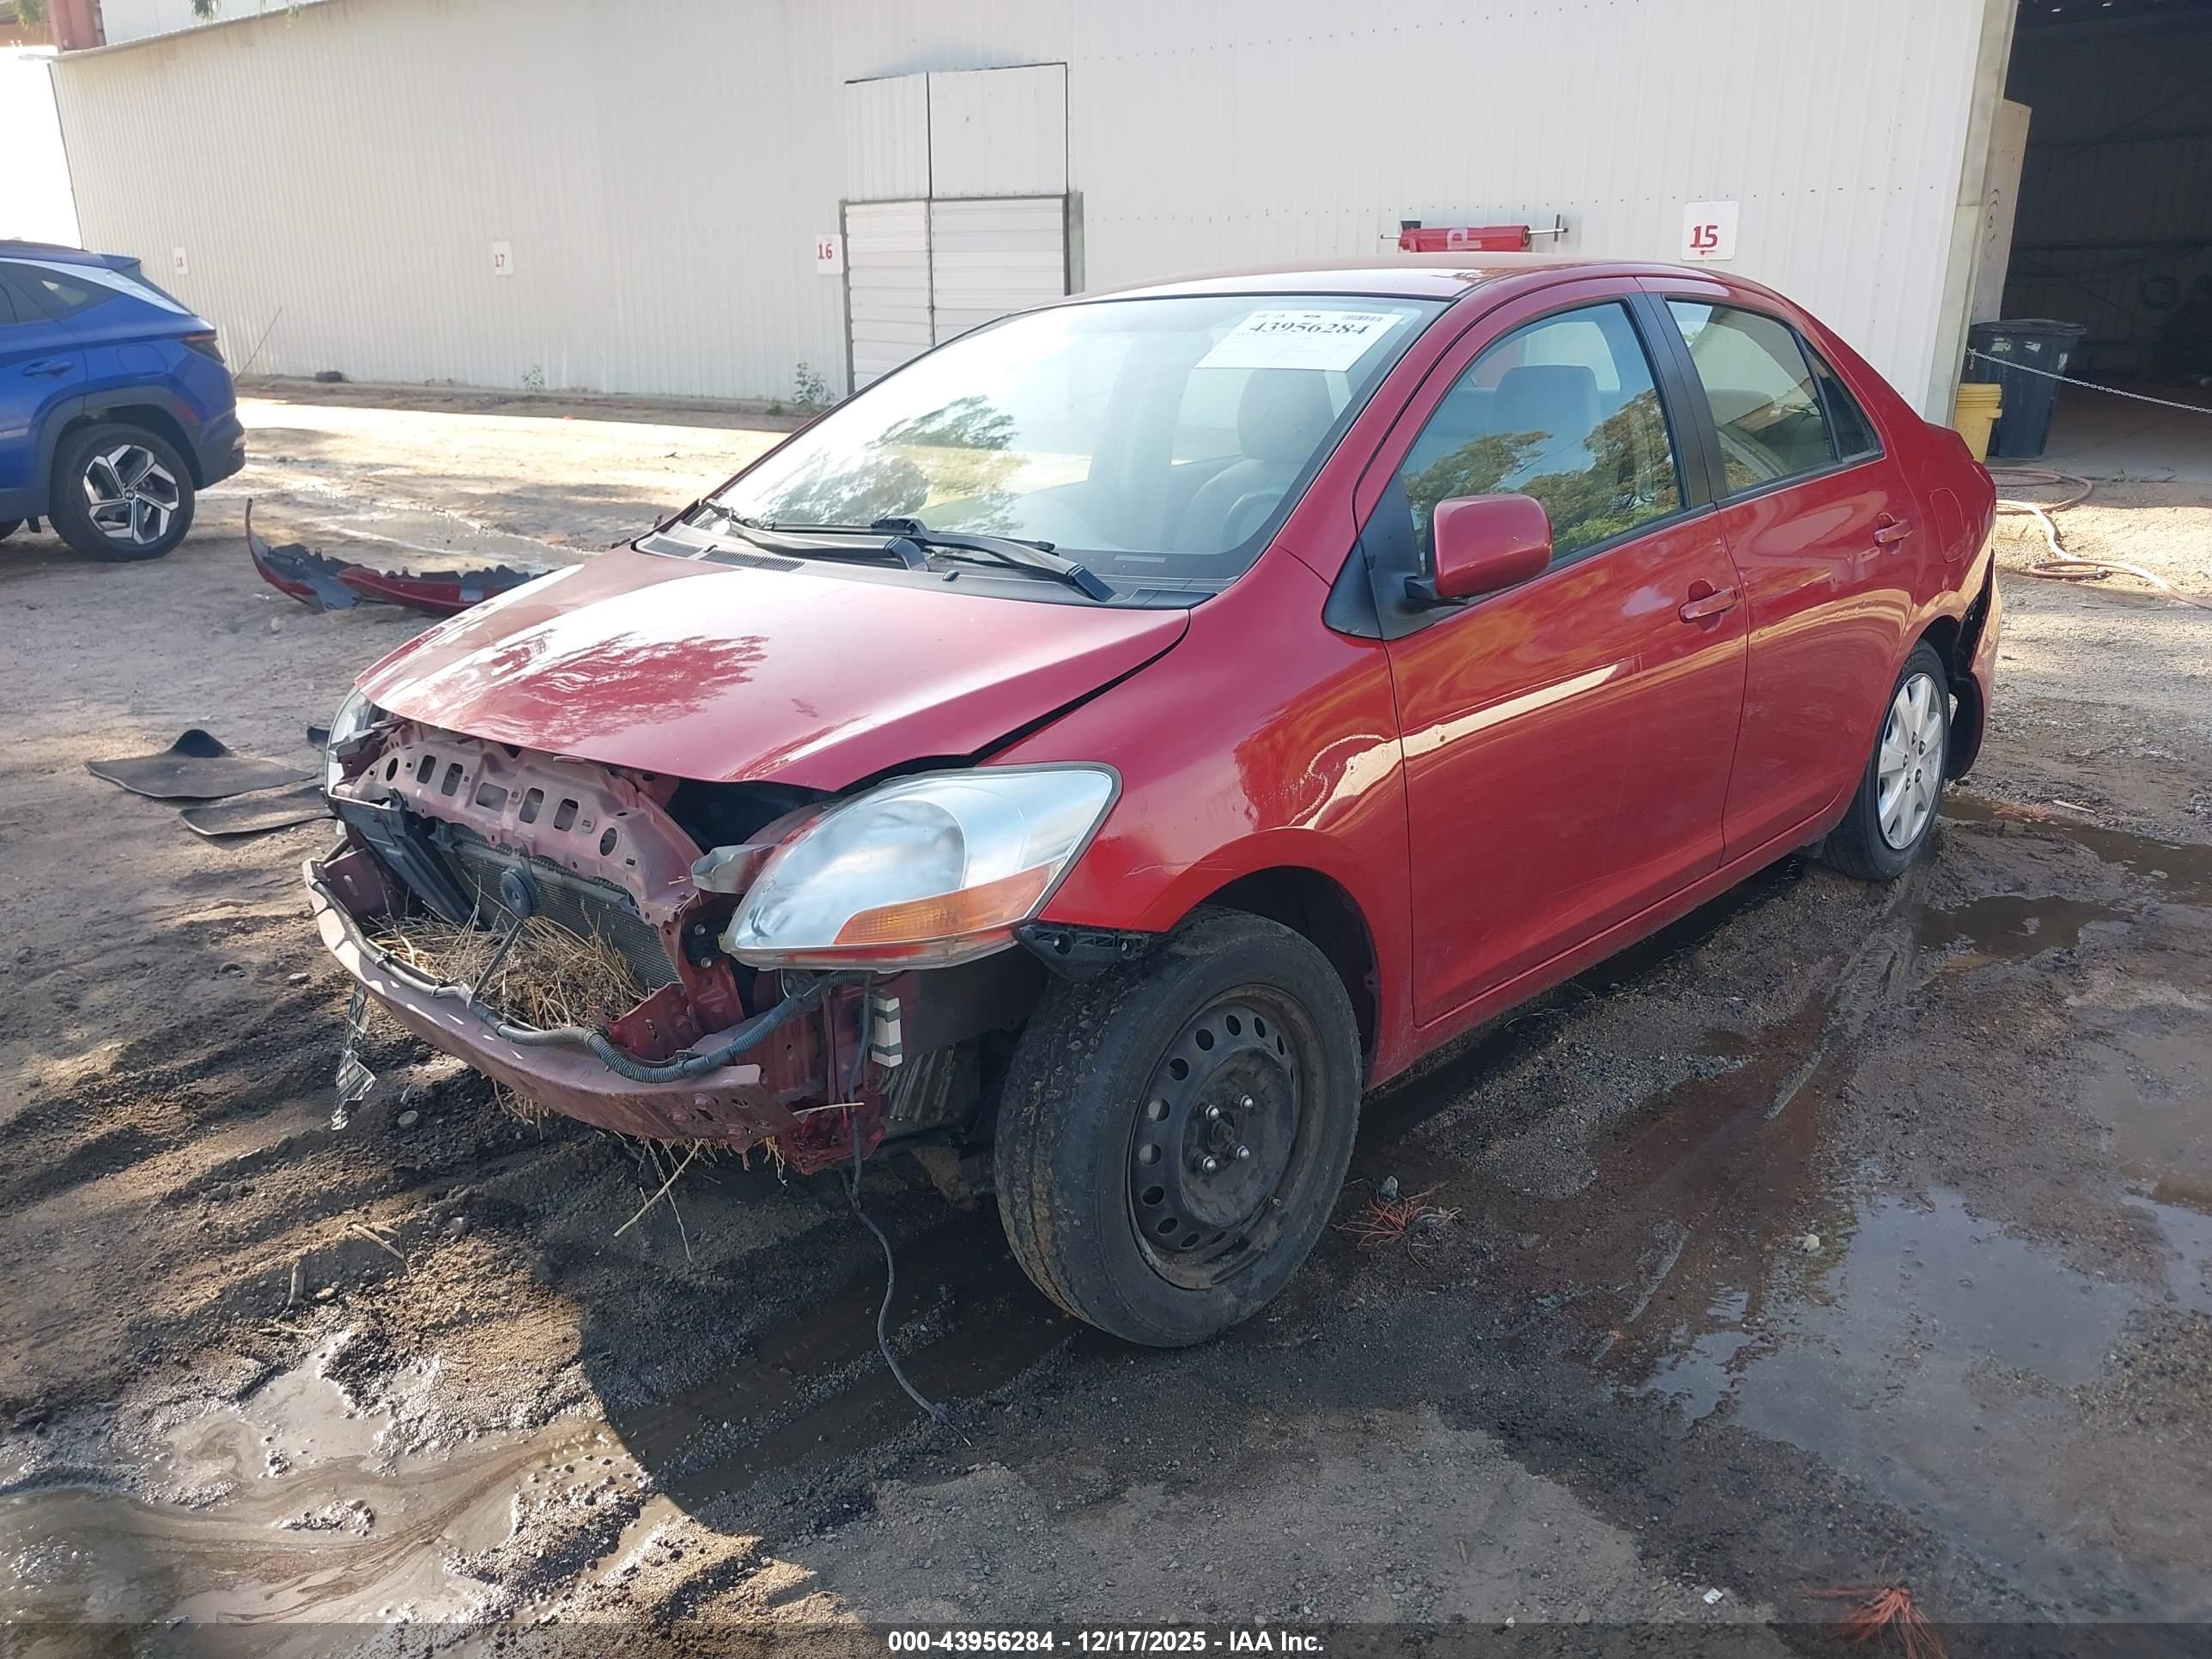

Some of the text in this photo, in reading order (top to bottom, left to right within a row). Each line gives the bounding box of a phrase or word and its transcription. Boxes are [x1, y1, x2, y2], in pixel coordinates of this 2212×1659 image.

[1689, 224, 1718, 248] 15
[817, 243, 833, 259] 16
[495, 254, 505, 267] 17
[1249, 322, 1370, 335] 43956284
